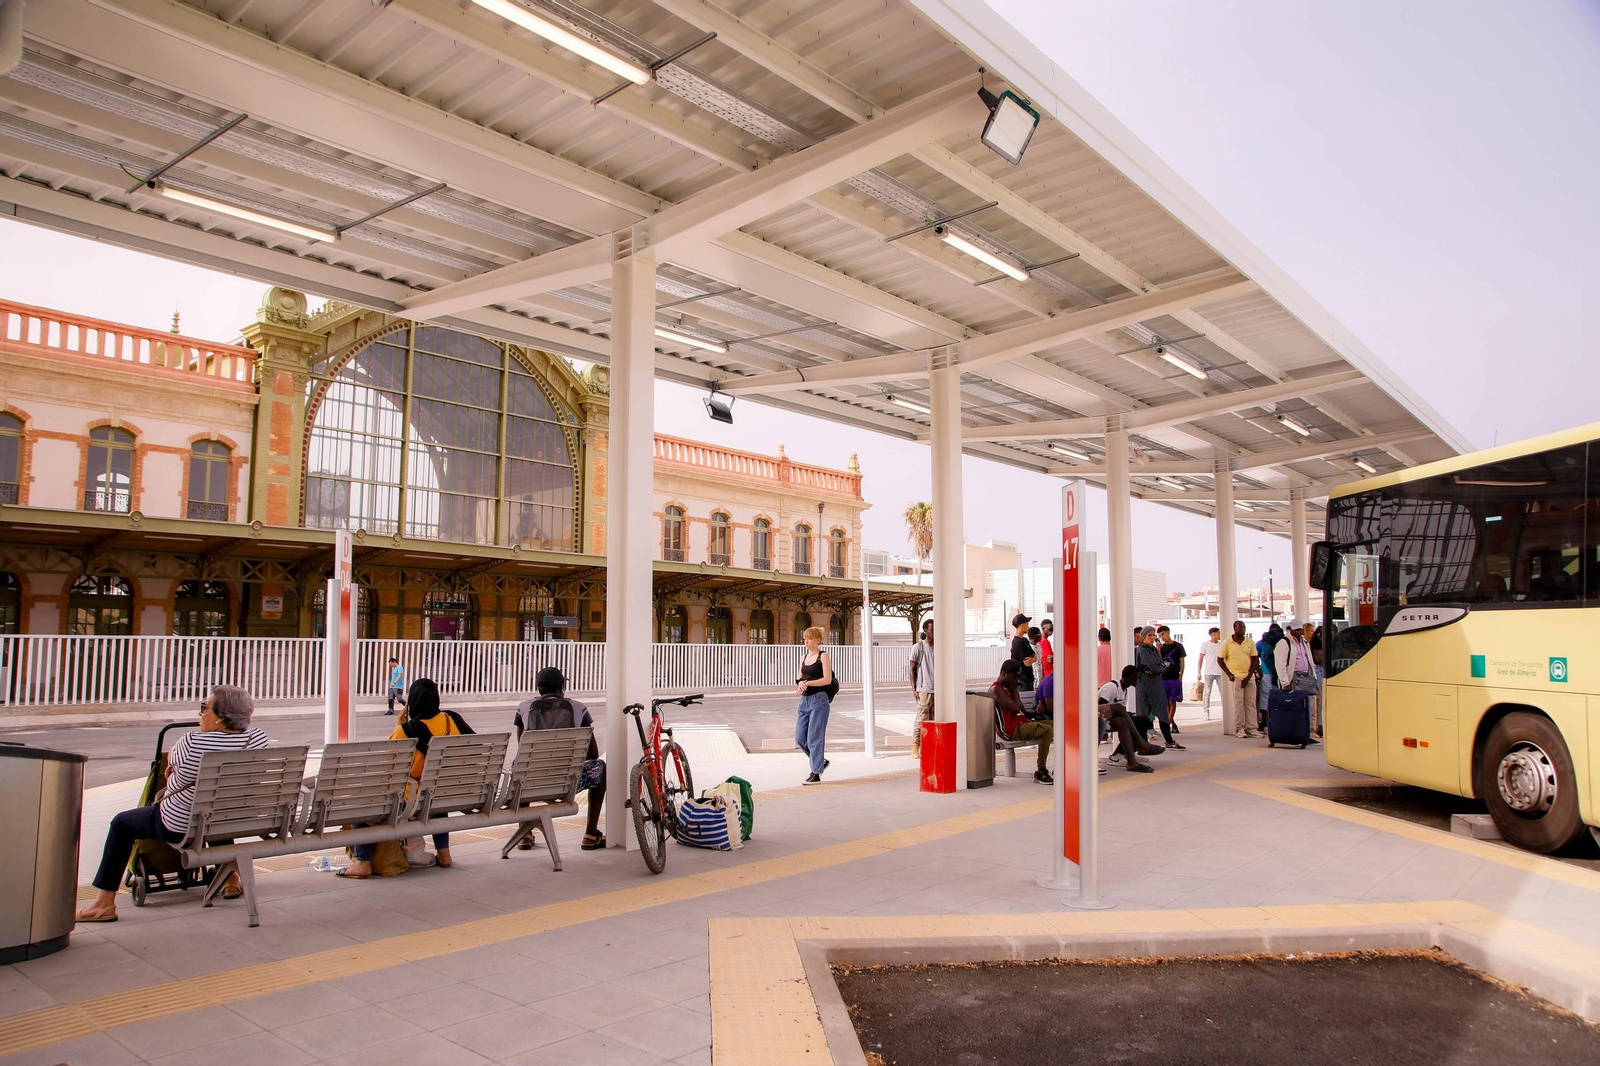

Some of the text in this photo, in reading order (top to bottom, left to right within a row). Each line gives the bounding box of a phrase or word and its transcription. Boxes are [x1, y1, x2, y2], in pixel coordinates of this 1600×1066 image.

[1067, 490, 1074, 522] D
[343, 536, 349, 558] D
[1063, 536, 1079, 570] 17
[340, 569, 351, 593] 04
[1359, 587, 1374, 605] 18
[1509, 668, 1516, 676] de
